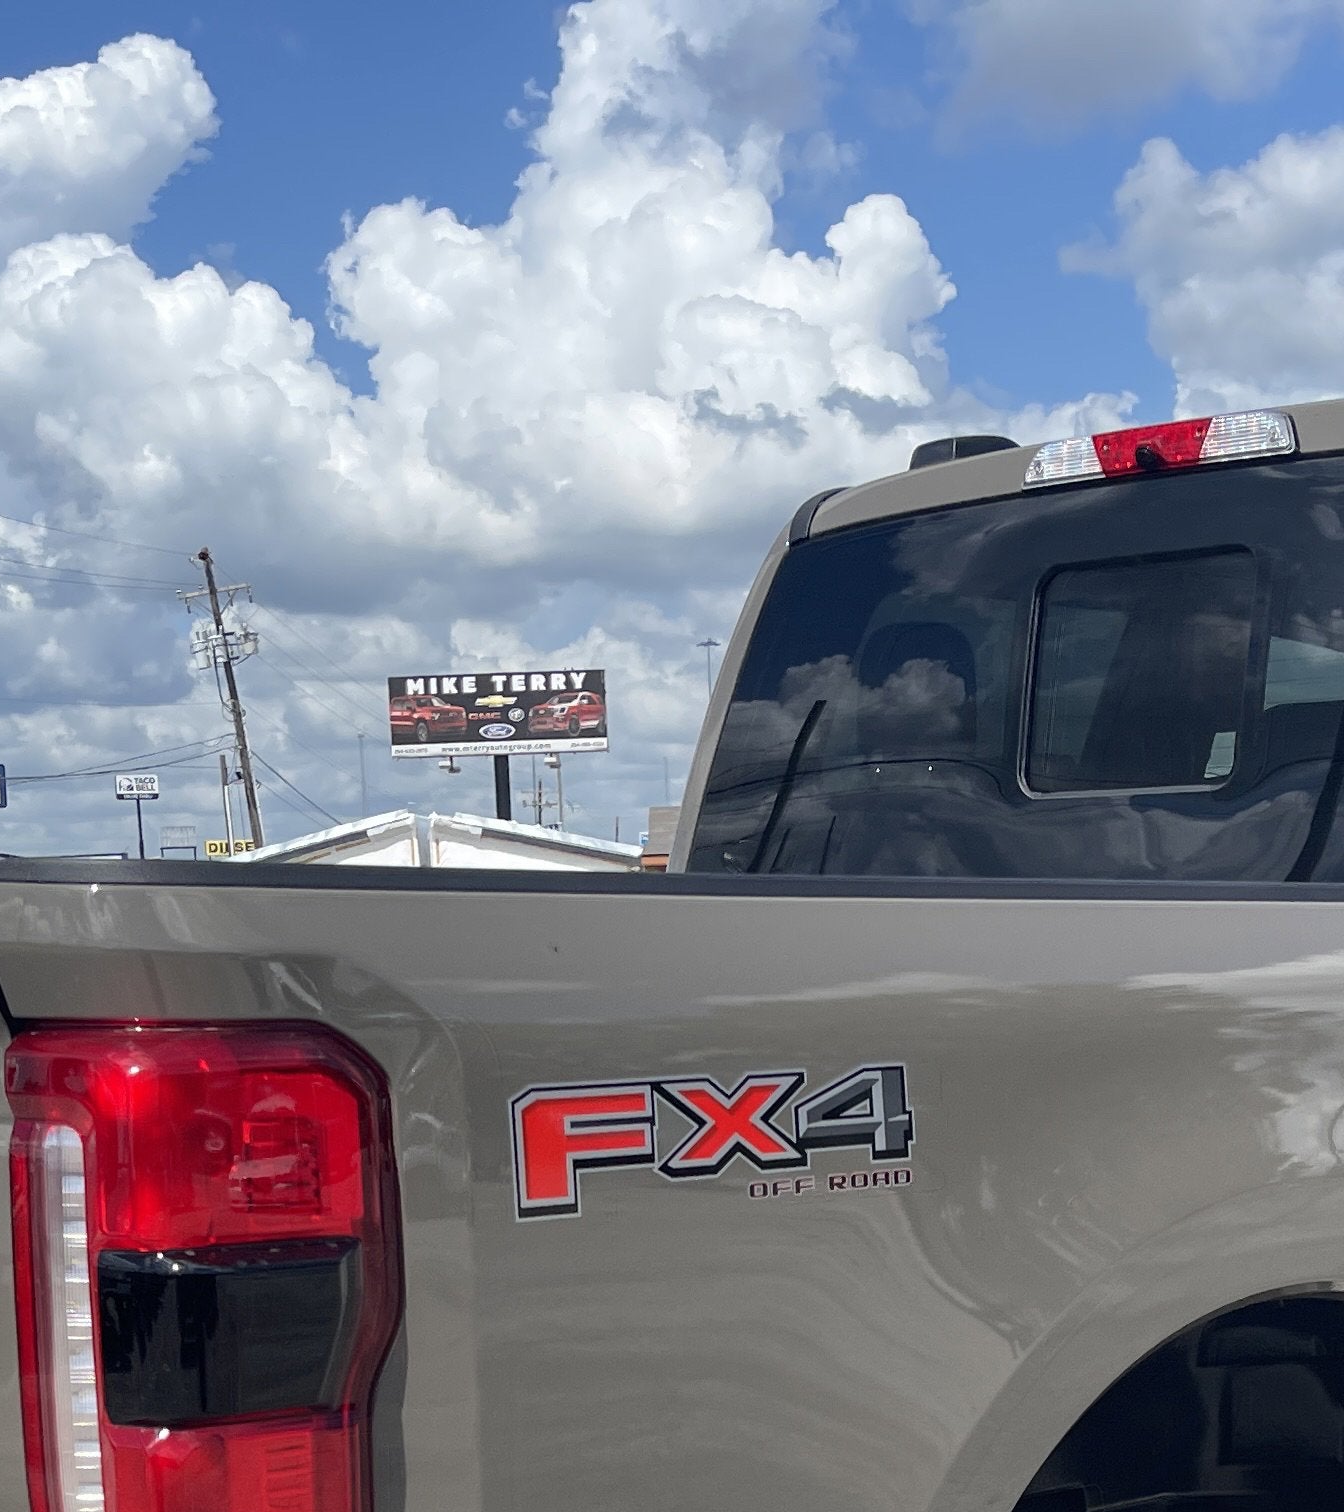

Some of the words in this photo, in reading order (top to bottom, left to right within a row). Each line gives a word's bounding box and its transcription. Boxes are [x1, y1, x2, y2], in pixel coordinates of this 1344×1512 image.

[406, 675, 478, 696] MIKE
[490, 672, 587, 693] TERRY
[468, 711, 501, 721] GMC
[133, 776, 156, 784] TACO
[135, 784, 156, 792] BELL
[509, 1063, 914, 1221] FX4
[748, 1174, 815, 1199] OFF
[827, 1167, 913, 1192] ROAD
